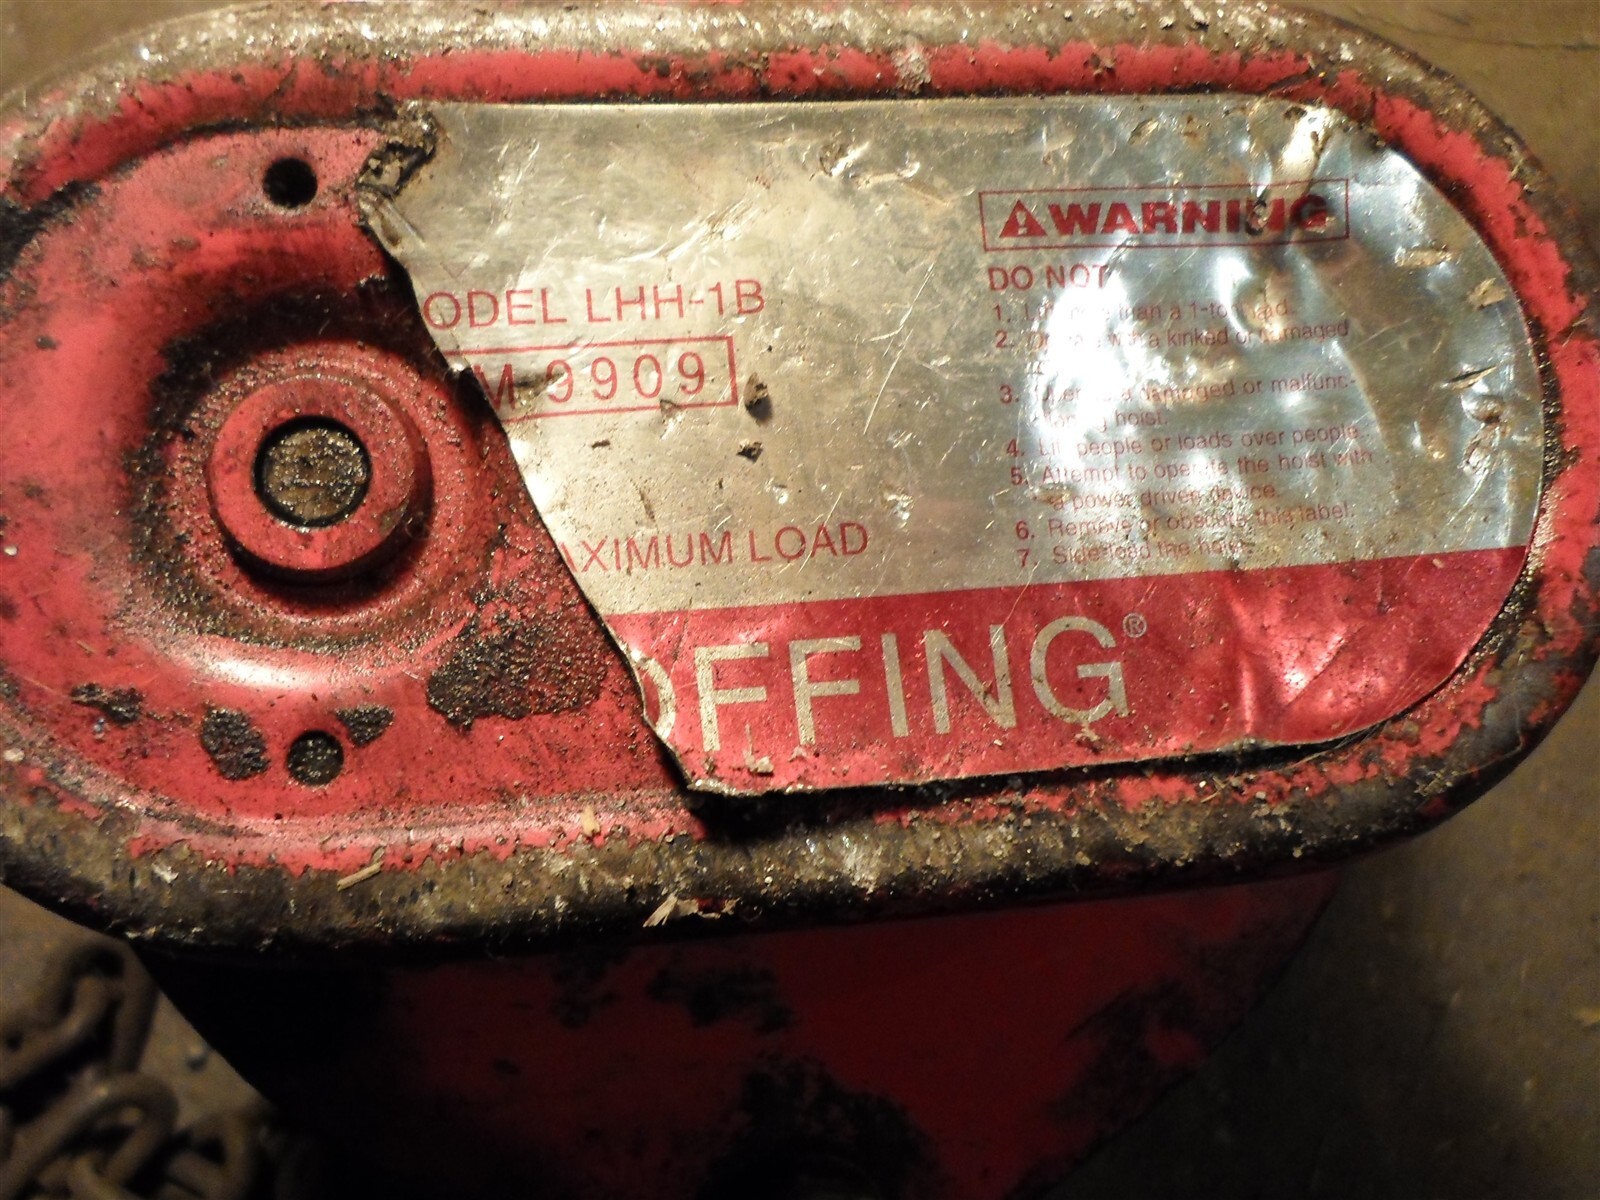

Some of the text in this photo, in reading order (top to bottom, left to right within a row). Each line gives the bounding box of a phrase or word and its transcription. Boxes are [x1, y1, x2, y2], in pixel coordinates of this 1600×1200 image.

[1048, 194, 1328, 237] WARNING
[988, 263, 1108, 291] DO NOT
[586, 279, 765, 323] LHH-1B
[1149, 332, 1160, 349] a
[1167, 326, 1228, 348] kinked
[546, 351, 705, 403] 9909
[1000, 385, 1020, 404] 3.
[1243, 379, 1262, 394] or
[1271, 370, 1356, 393] malfunc-
[1006, 439, 1025, 457] 4.
[1077, 436, 1143, 460] people
[1151, 437, 1171, 452] or
[1178, 431, 1232, 450] loads
[1241, 429, 1285, 447] over
[1010, 466, 1028, 486] 5.
[1042, 463, 1120, 484] Attempt
[1129, 463, 1147, 481] to
[1237, 456, 1269, 475] the
[1278, 452, 1326, 471] hoist
[1333, 448, 1372, 467] with
[1015, 519, 1035, 540] 6.
[1048, 517, 1133, 537] Remove
[1256, 508, 1294, 526] this
[749, 521, 868, 563] LOAD
[1157, 541, 1190, 558] the
